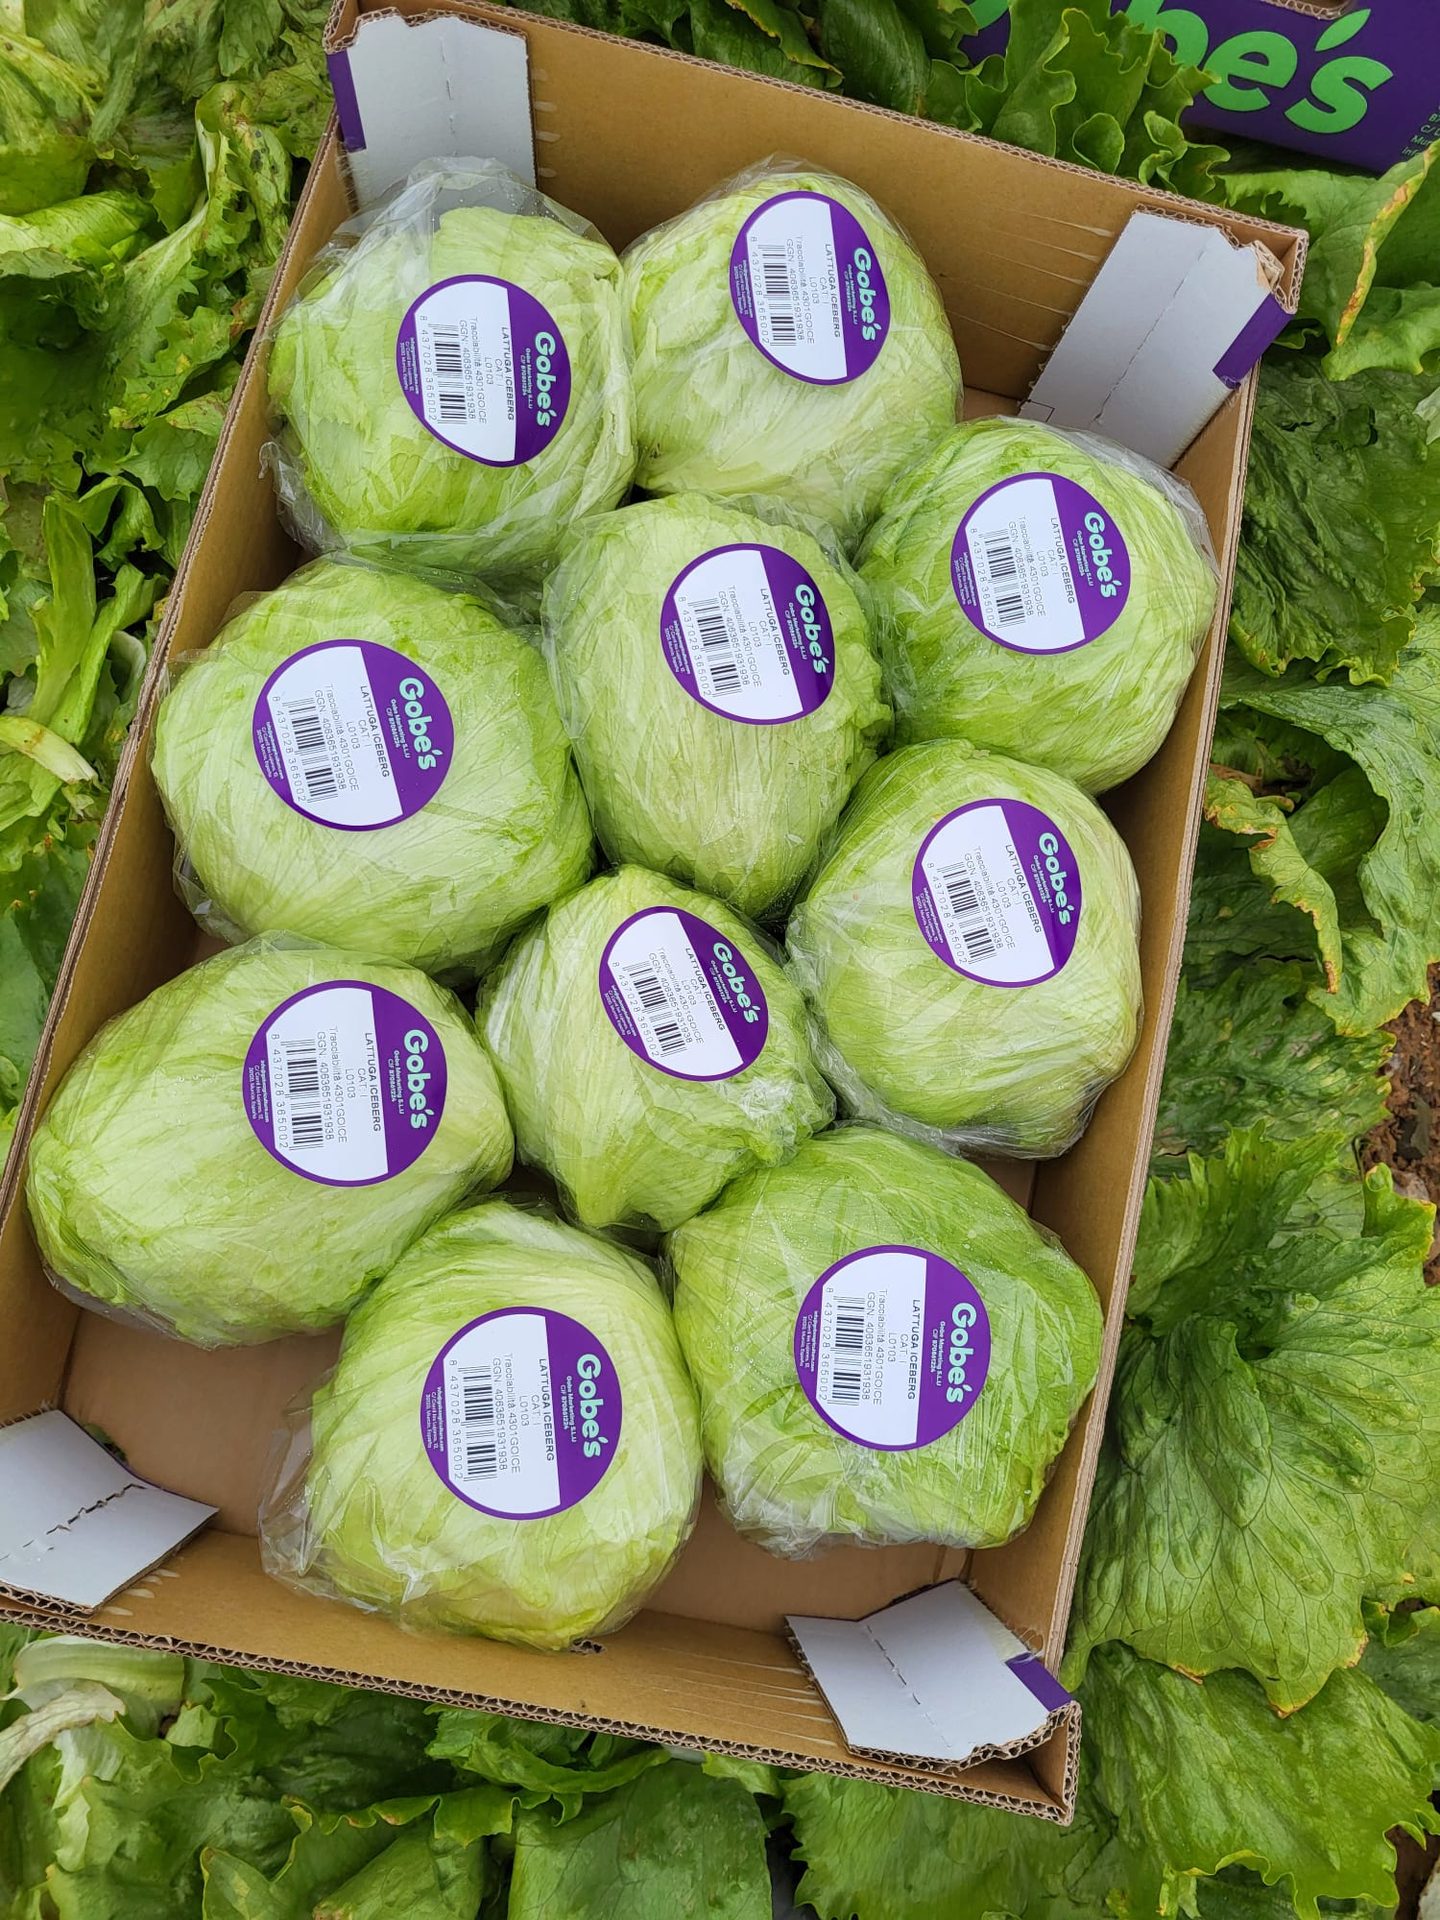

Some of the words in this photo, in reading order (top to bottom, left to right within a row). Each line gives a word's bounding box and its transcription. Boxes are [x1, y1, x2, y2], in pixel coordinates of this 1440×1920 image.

[808, 276, 819, 304] L0103
[824, 243, 835, 289] LATTUGA
[854, 248, 880, 340] Gobe's
[789, 267, 804, 340] 4063651931938
[829, 292, 841, 337] ICEBERG
[461, 347, 475, 419] 4063651931938
[484, 356, 493, 384] L0103
[501, 326, 510, 373] LATTUGA
[535, 332, 556, 426] Gobe's
[504, 376, 514, 420] ICEBERG
[1013, 547, 1033, 616] 4063651931938
[1036, 550, 1048, 576] L0103
[1049, 517, 1065, 560] LATTUGA
[1059, 562, 1074, 603] ICEBERG
[1084, 512, 1121, 598] Gobe's
[724, 616, 749, 685] 4063651931938
[747, 620, 761, 648] L0103
[760, 587, 778, 631] LATTUGA
[772, 633, 789, 676] ICEBERG
[795, 584, 826, 674] Gobe's
[321, 717, 346, 789] 4063651931938
[346, 721, 359, 749] L0103
[360, 685, 378, 731] LATTUGA
[371, 733, 389, 777] ICEBERG
[399, 678, 441, 770] Gobe's
[995, 881, 1010, 908] L0103
[1004, 844, 1026, 889] LATTUGA
[1020, 890, 1041, 933] ICEBERG
[1039, 833, 1073, 924] Gobe's
[972, 879, 1003, 949] 4063651931938
[684, 946, 707, 989] LATTUGA
[703, 990, 725, 1031] ICEBERG
[713, 943, 757, 1023] Gobe's
[345, 1068, 355, 1098] L0103
[364, 1032, 376, 1081] LATTUGA
[404, 1029, 433, 1129] Gobe's
[319, 1062, 333, 1140] 4063651931938
[369, 1084, 381, 1131] ICEBERG
[886, 1331, 896, 1362] L0103
[910, 1299, 920, 1349] LATTUGA
[946, 1303, 977, 1403] Gobe's
[538, 1358, 550, 1408] LATTUGA
[861, 1321, 873, 1400] 4063651931938
[907, 1352, 917, 1399] ICEBERG
[494, 1388, 507, 1470] 4063651931938
[518, 1395, 529, 1426] L0103
[543, 1411, 554, 1461] ICEBERG
[577, 1354, 608, 1458] Gobe's
